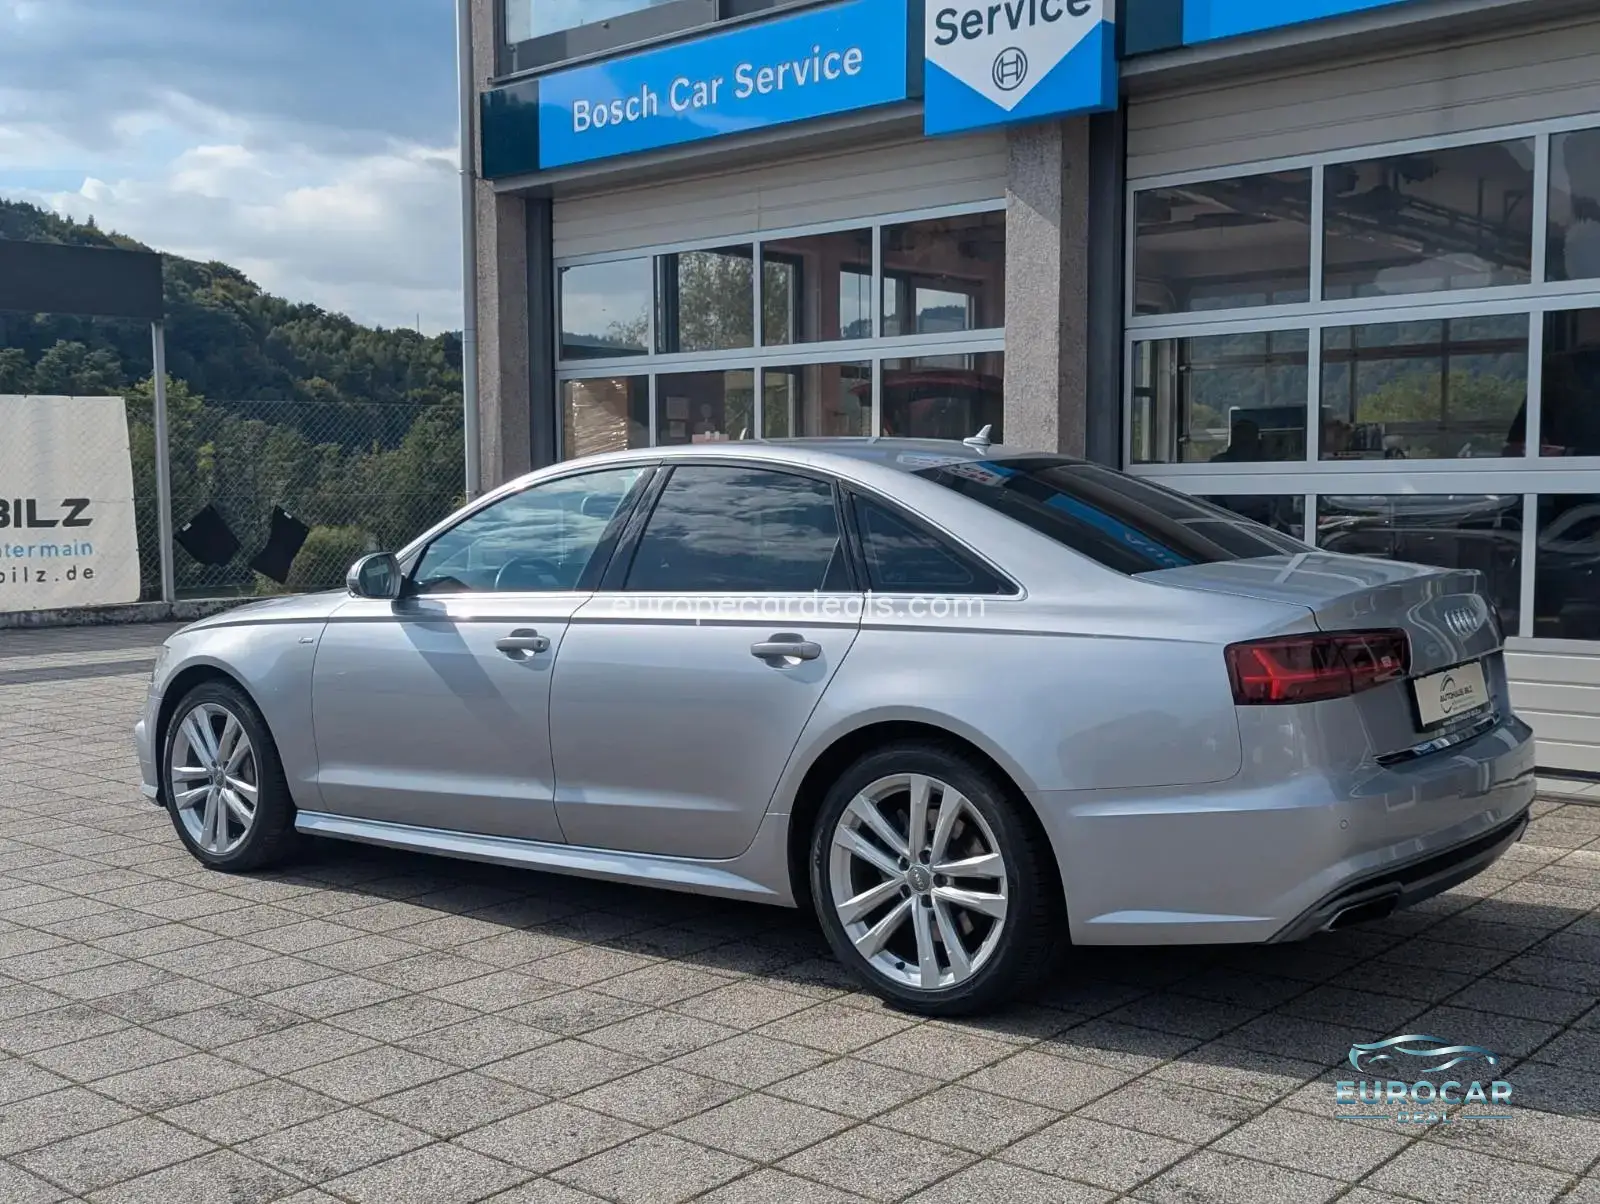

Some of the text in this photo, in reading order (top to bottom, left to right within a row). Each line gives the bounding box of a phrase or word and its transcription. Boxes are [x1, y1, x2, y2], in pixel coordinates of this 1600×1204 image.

[934, 0, 1091, 45] Service
[573, 45, 863, 133] Bosch Car Service
[0, 539, 93, 558] termain
